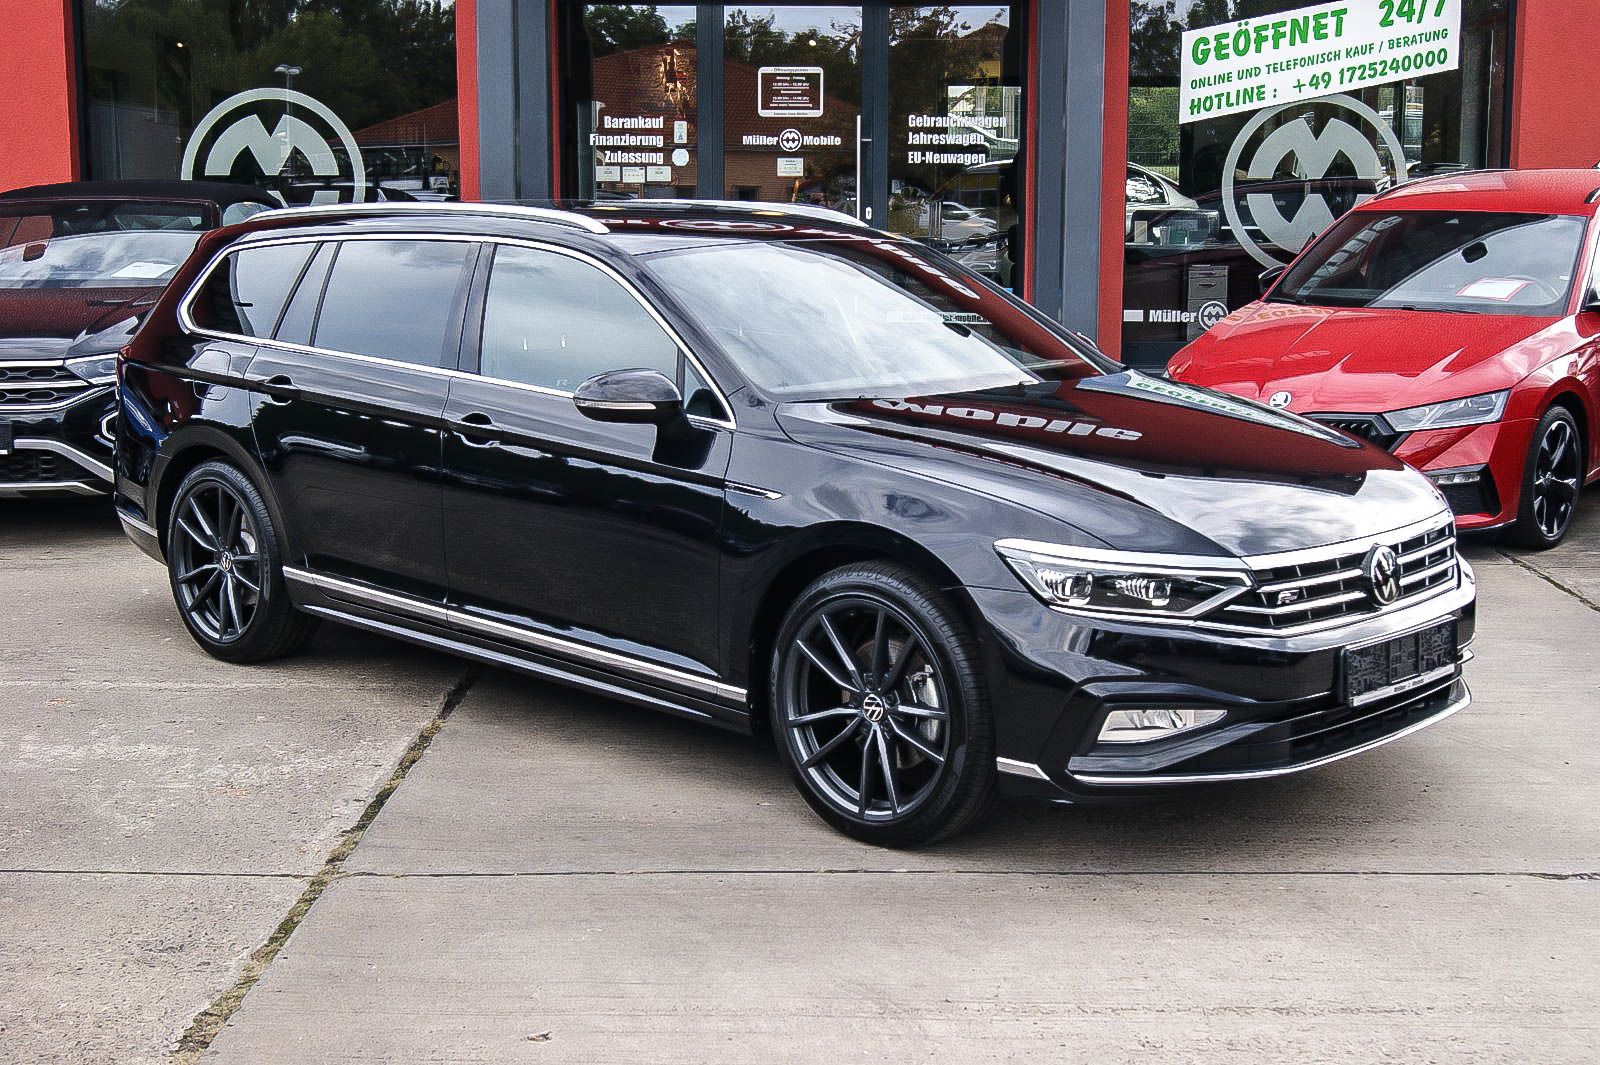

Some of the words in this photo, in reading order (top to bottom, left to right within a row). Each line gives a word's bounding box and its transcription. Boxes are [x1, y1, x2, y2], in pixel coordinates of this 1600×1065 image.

[1191, 8, 1348, 65] GEÖFFNET
[1190, 72, 1233, 90] ONLINE
[1237, 65, 1261, 81] UND
[1265, 49, 1342, 75] TELEFONISCH
[1345, 43, 1375, 59] KAUF
[1388, 28, 1449, 49] BERATUNG
[1189, 84, 1266, 115] HOTLINE
[1292, 71, 1332, 94] +49
[1338, 48, 1448, 85] 1725240000
[604, 116, 664, 129] Barankauf
[590, 133, 664, 147] Finanzierung
[742, 135, 778, 146] Müller
[803, 135, 841, 146] Mobile
[908, 132, 984, 145] Jahreswagen
[604, 151, 664, 164] Zulassung
[908, 151, 986, 165] EU-Neuwagen
[1149, 310, 1197, 322] Müller
